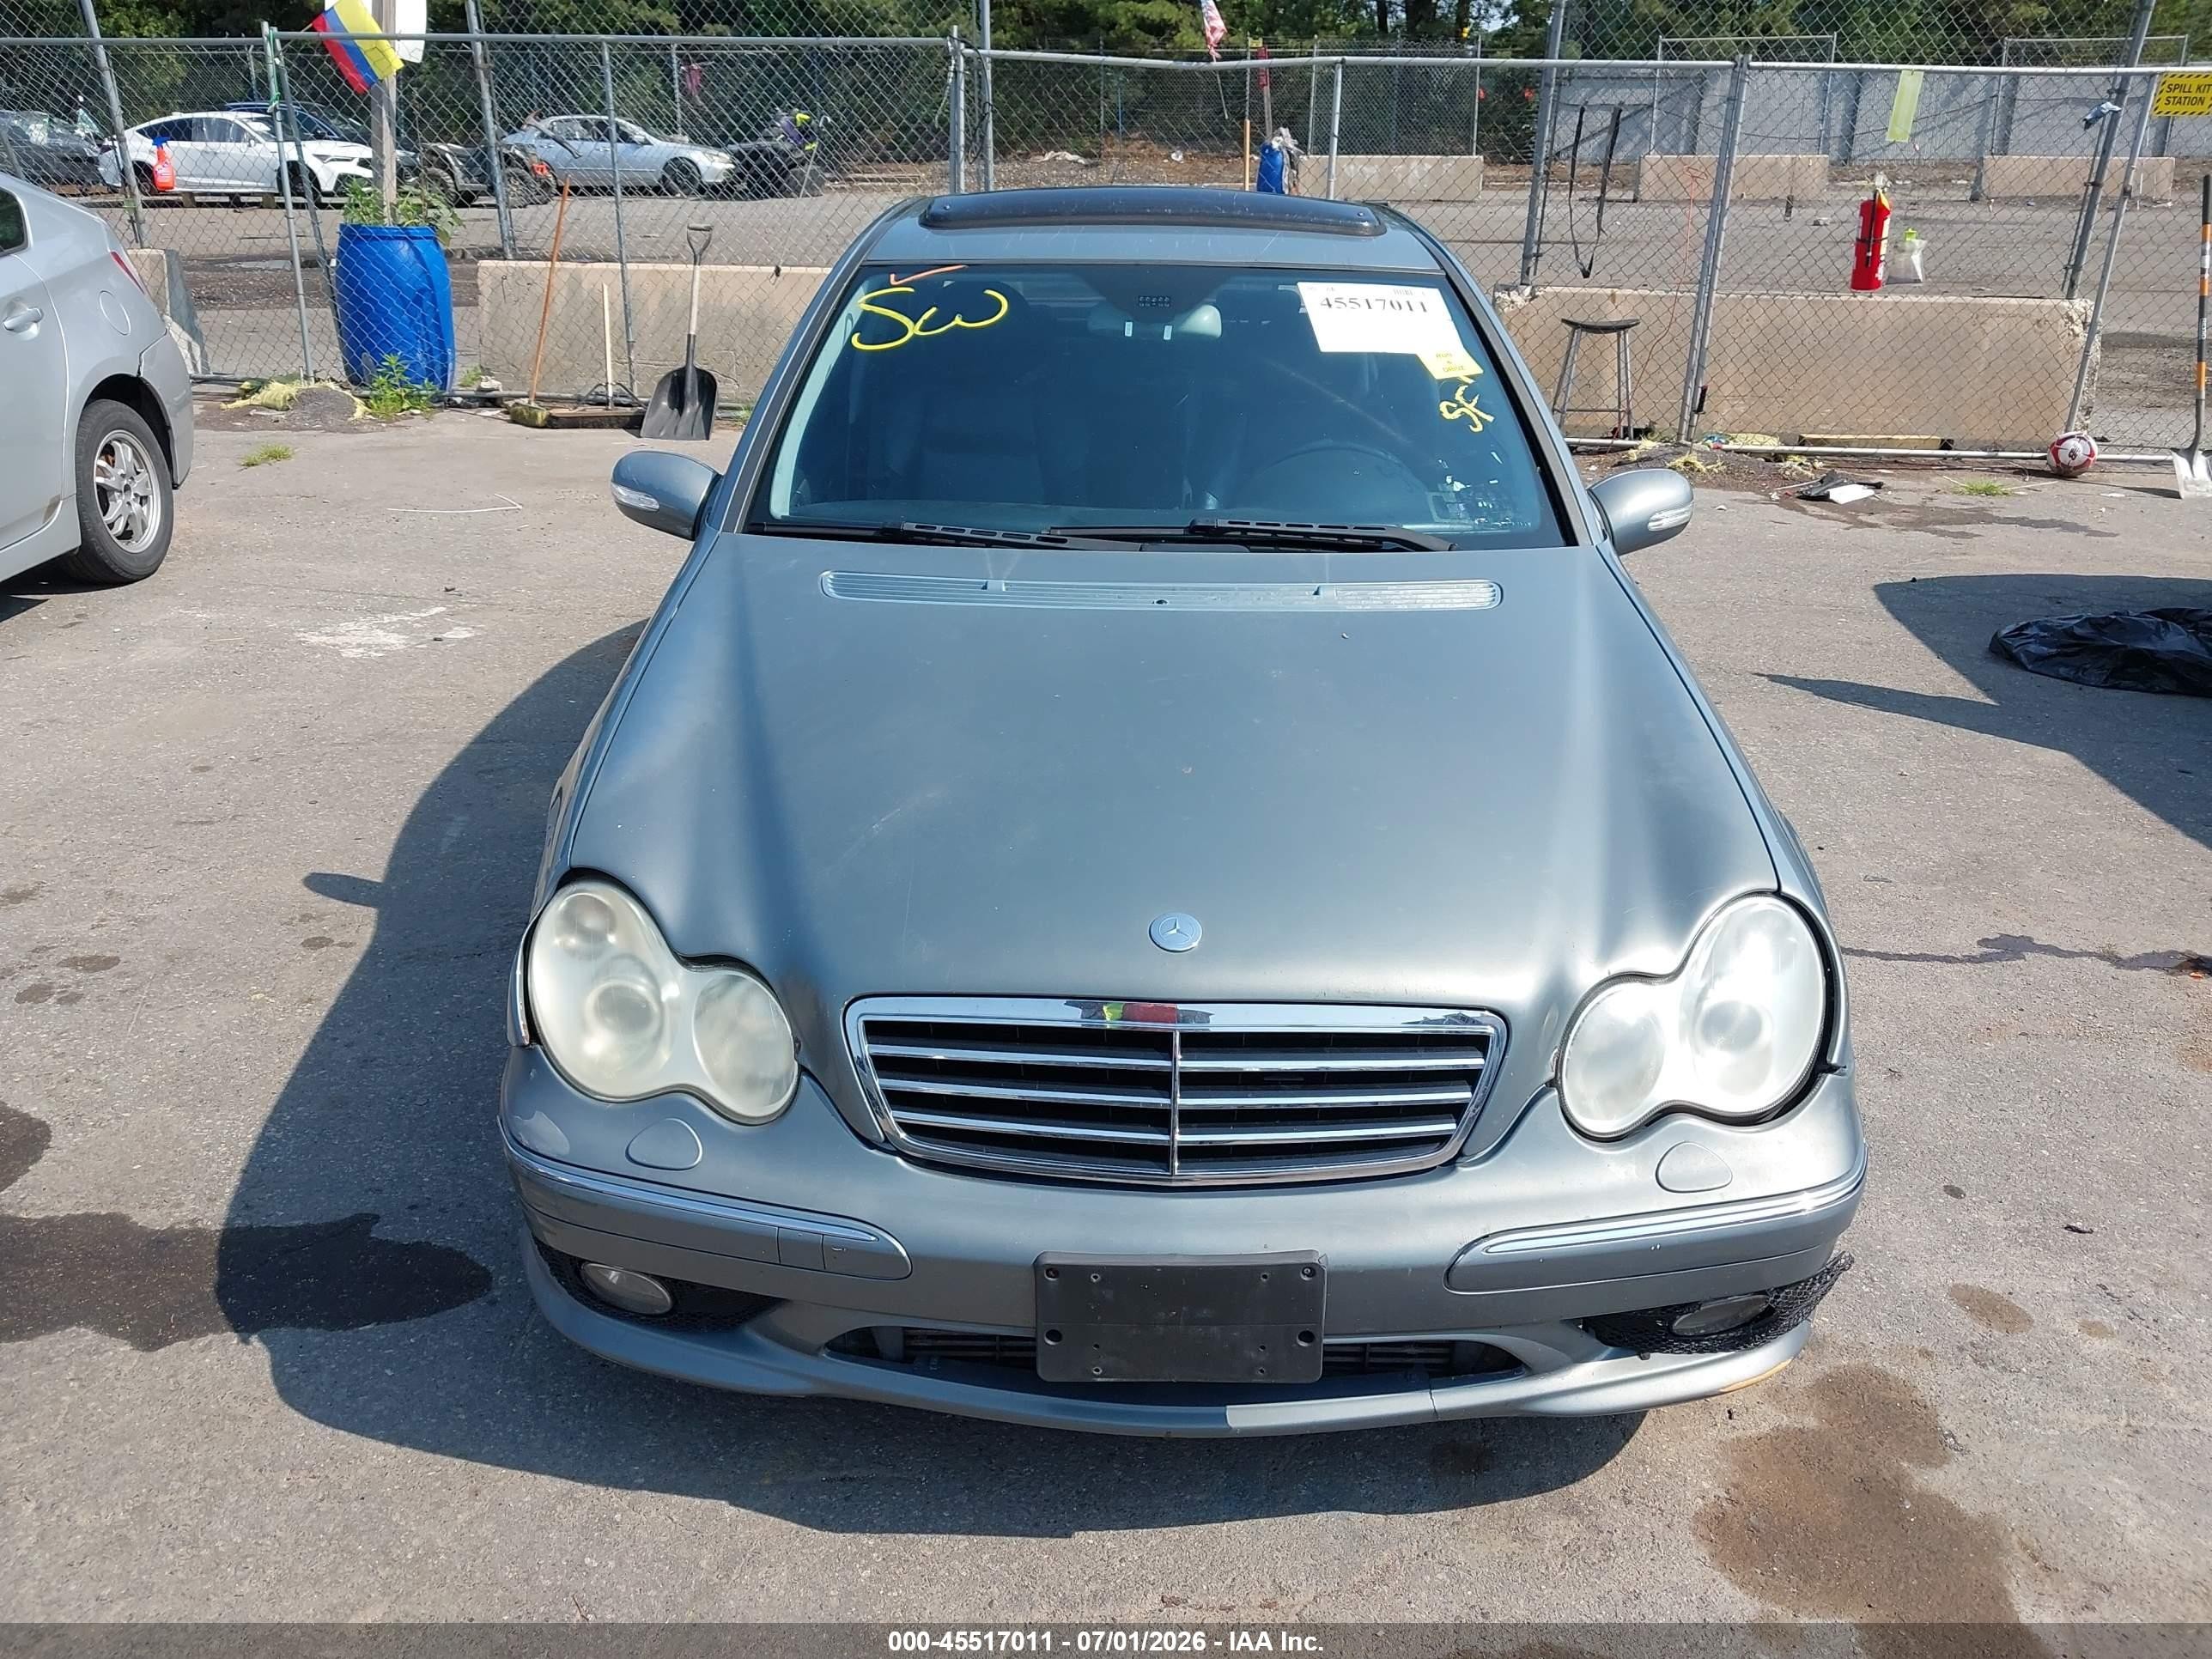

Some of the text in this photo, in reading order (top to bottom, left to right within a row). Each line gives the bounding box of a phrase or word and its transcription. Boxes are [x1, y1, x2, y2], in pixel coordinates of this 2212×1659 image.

[2166, 83, 2212, 94] SPILL KIT
[2164, 96, 2205, 106] STATION
[1320, 296, 1427, 313] 45517011
